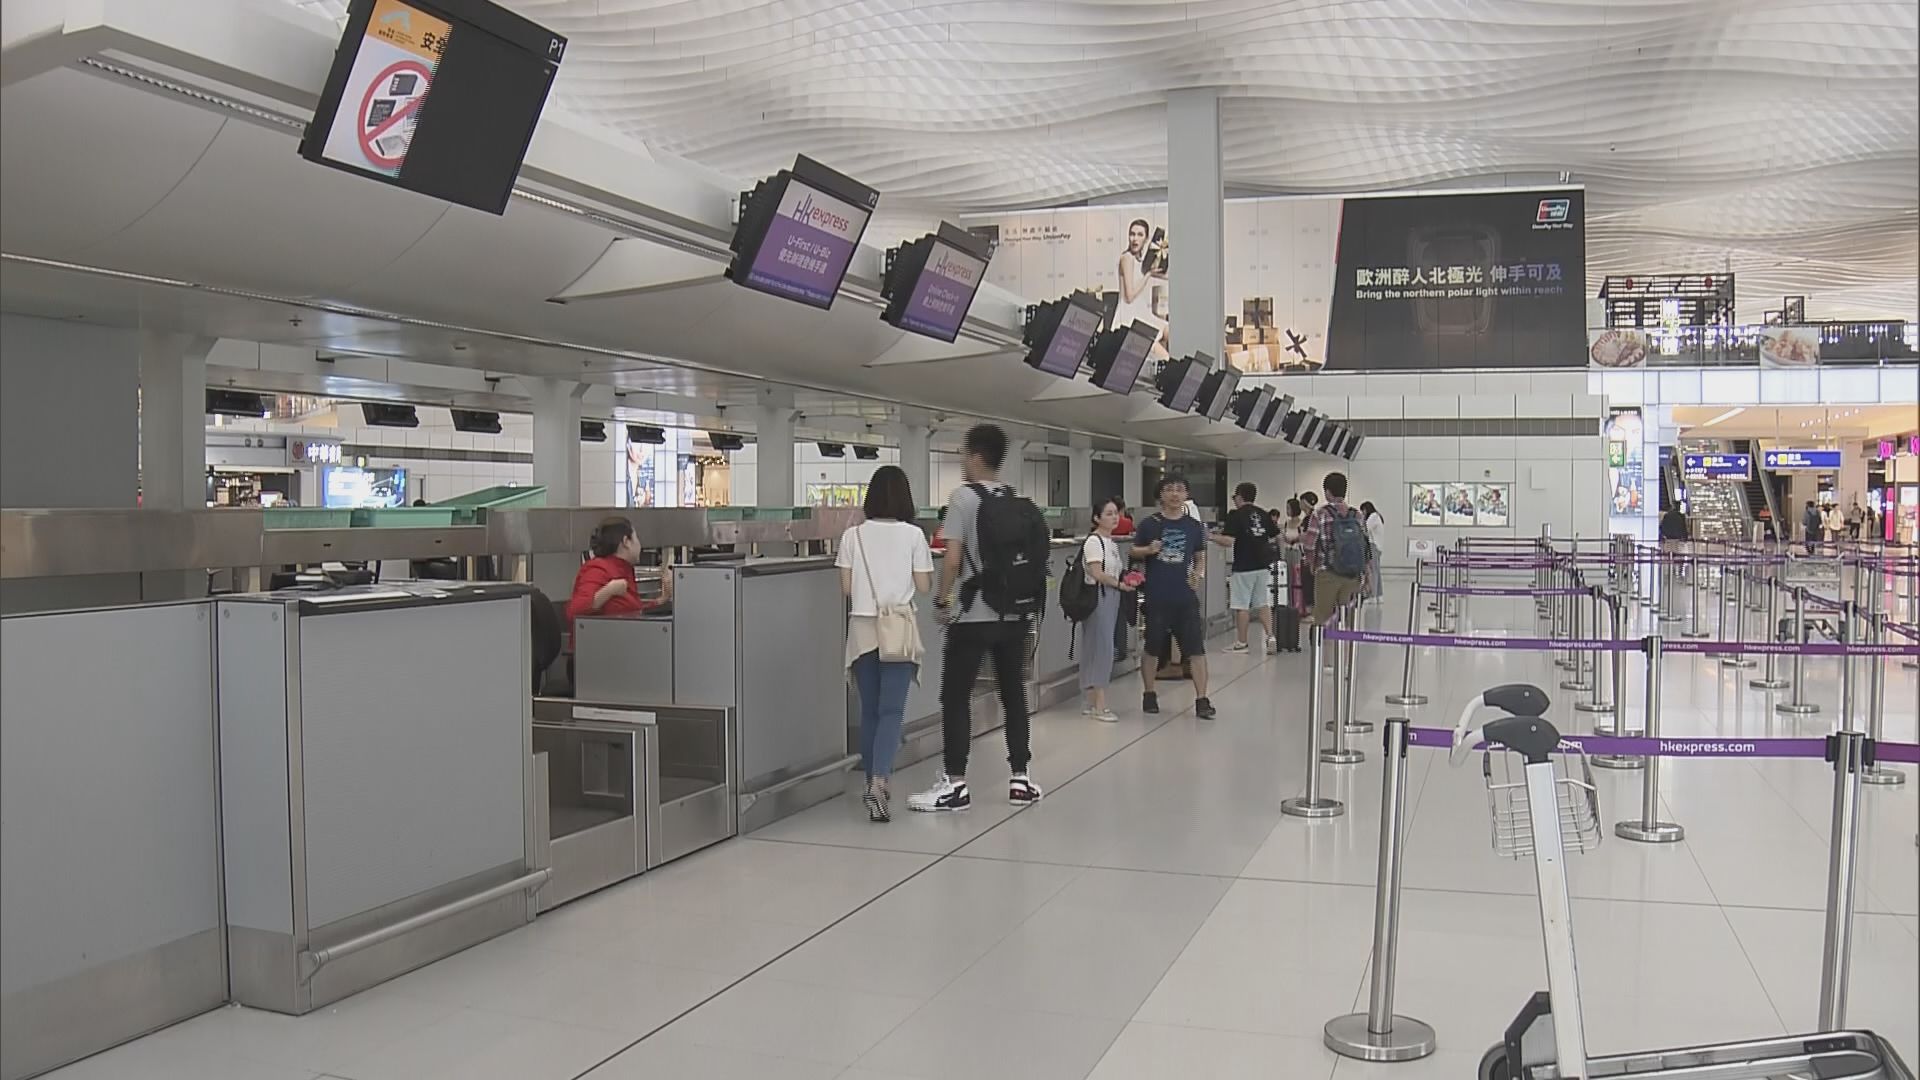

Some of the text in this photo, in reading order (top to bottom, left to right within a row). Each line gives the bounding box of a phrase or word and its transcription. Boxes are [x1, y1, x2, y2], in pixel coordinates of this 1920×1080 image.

[548, 38, 564, 58] P1
[868, 191, 878, 205] P2
[787, 234, 811, 251] U-First
[1356, 263, 1562, 286] 歐洲醉人北極光 伸手可及
[1356, 285, 1563, 300] Bring the northern polar light within reach
[1362, 633, 1603, 650] hkexpress.com hkexpress.com hkexpress.com
[1662, 641, 1904, 655] press.com hkexpress.com hkexpress.com
[1659, 739, 1755, 756] hkexpress.com
